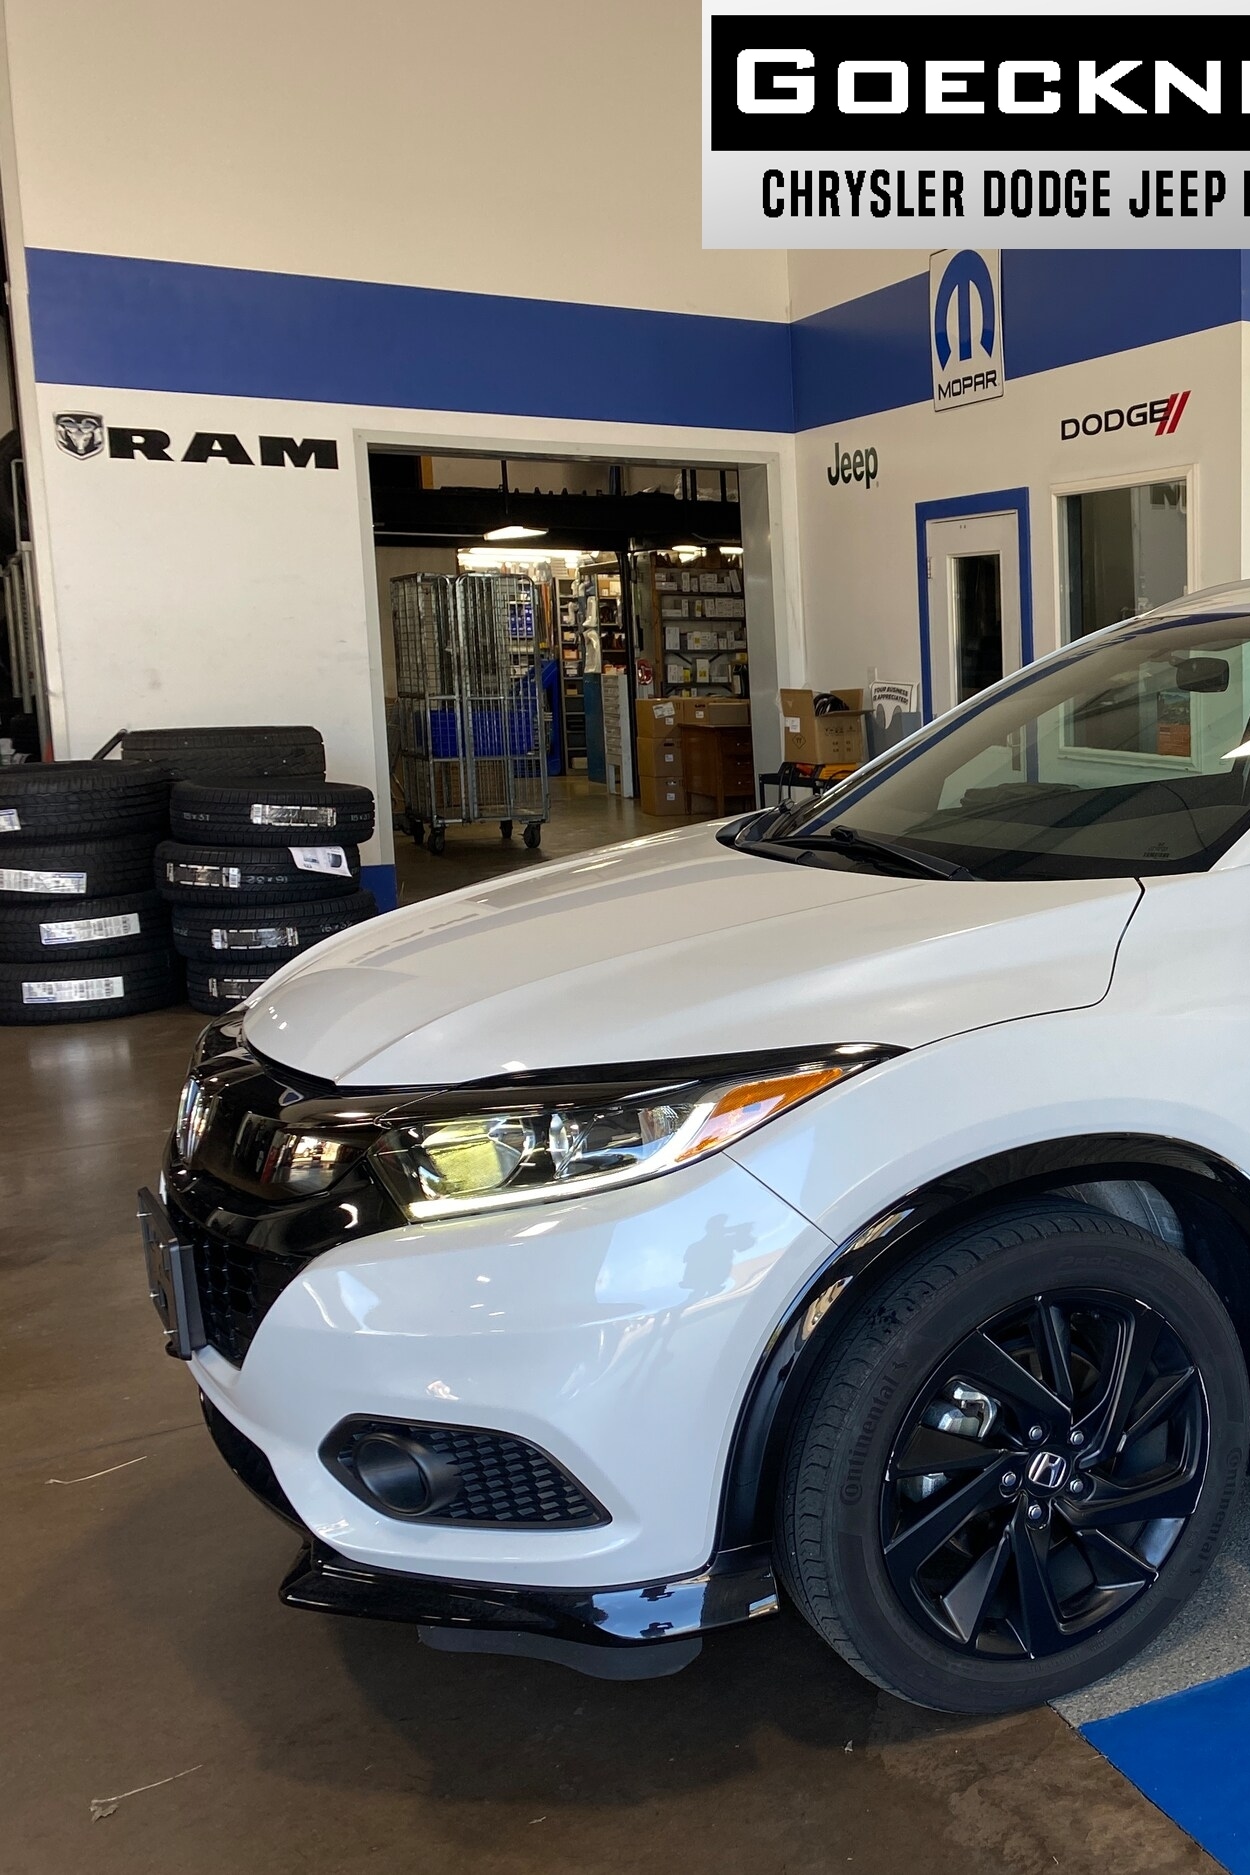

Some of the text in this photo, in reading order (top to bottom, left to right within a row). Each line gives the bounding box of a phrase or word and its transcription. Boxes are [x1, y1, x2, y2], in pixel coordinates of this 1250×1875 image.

[937, 368, 998, 402] MOPAR
[1060, 398, 1171, 442] DODGE
[107, 426, 340, 470] RAM
[826, 442, 880, 490] Jeep
[873, 686, 909, 698] YOUR BUSINESS
[839, 1374, 900, 1506] Continental
